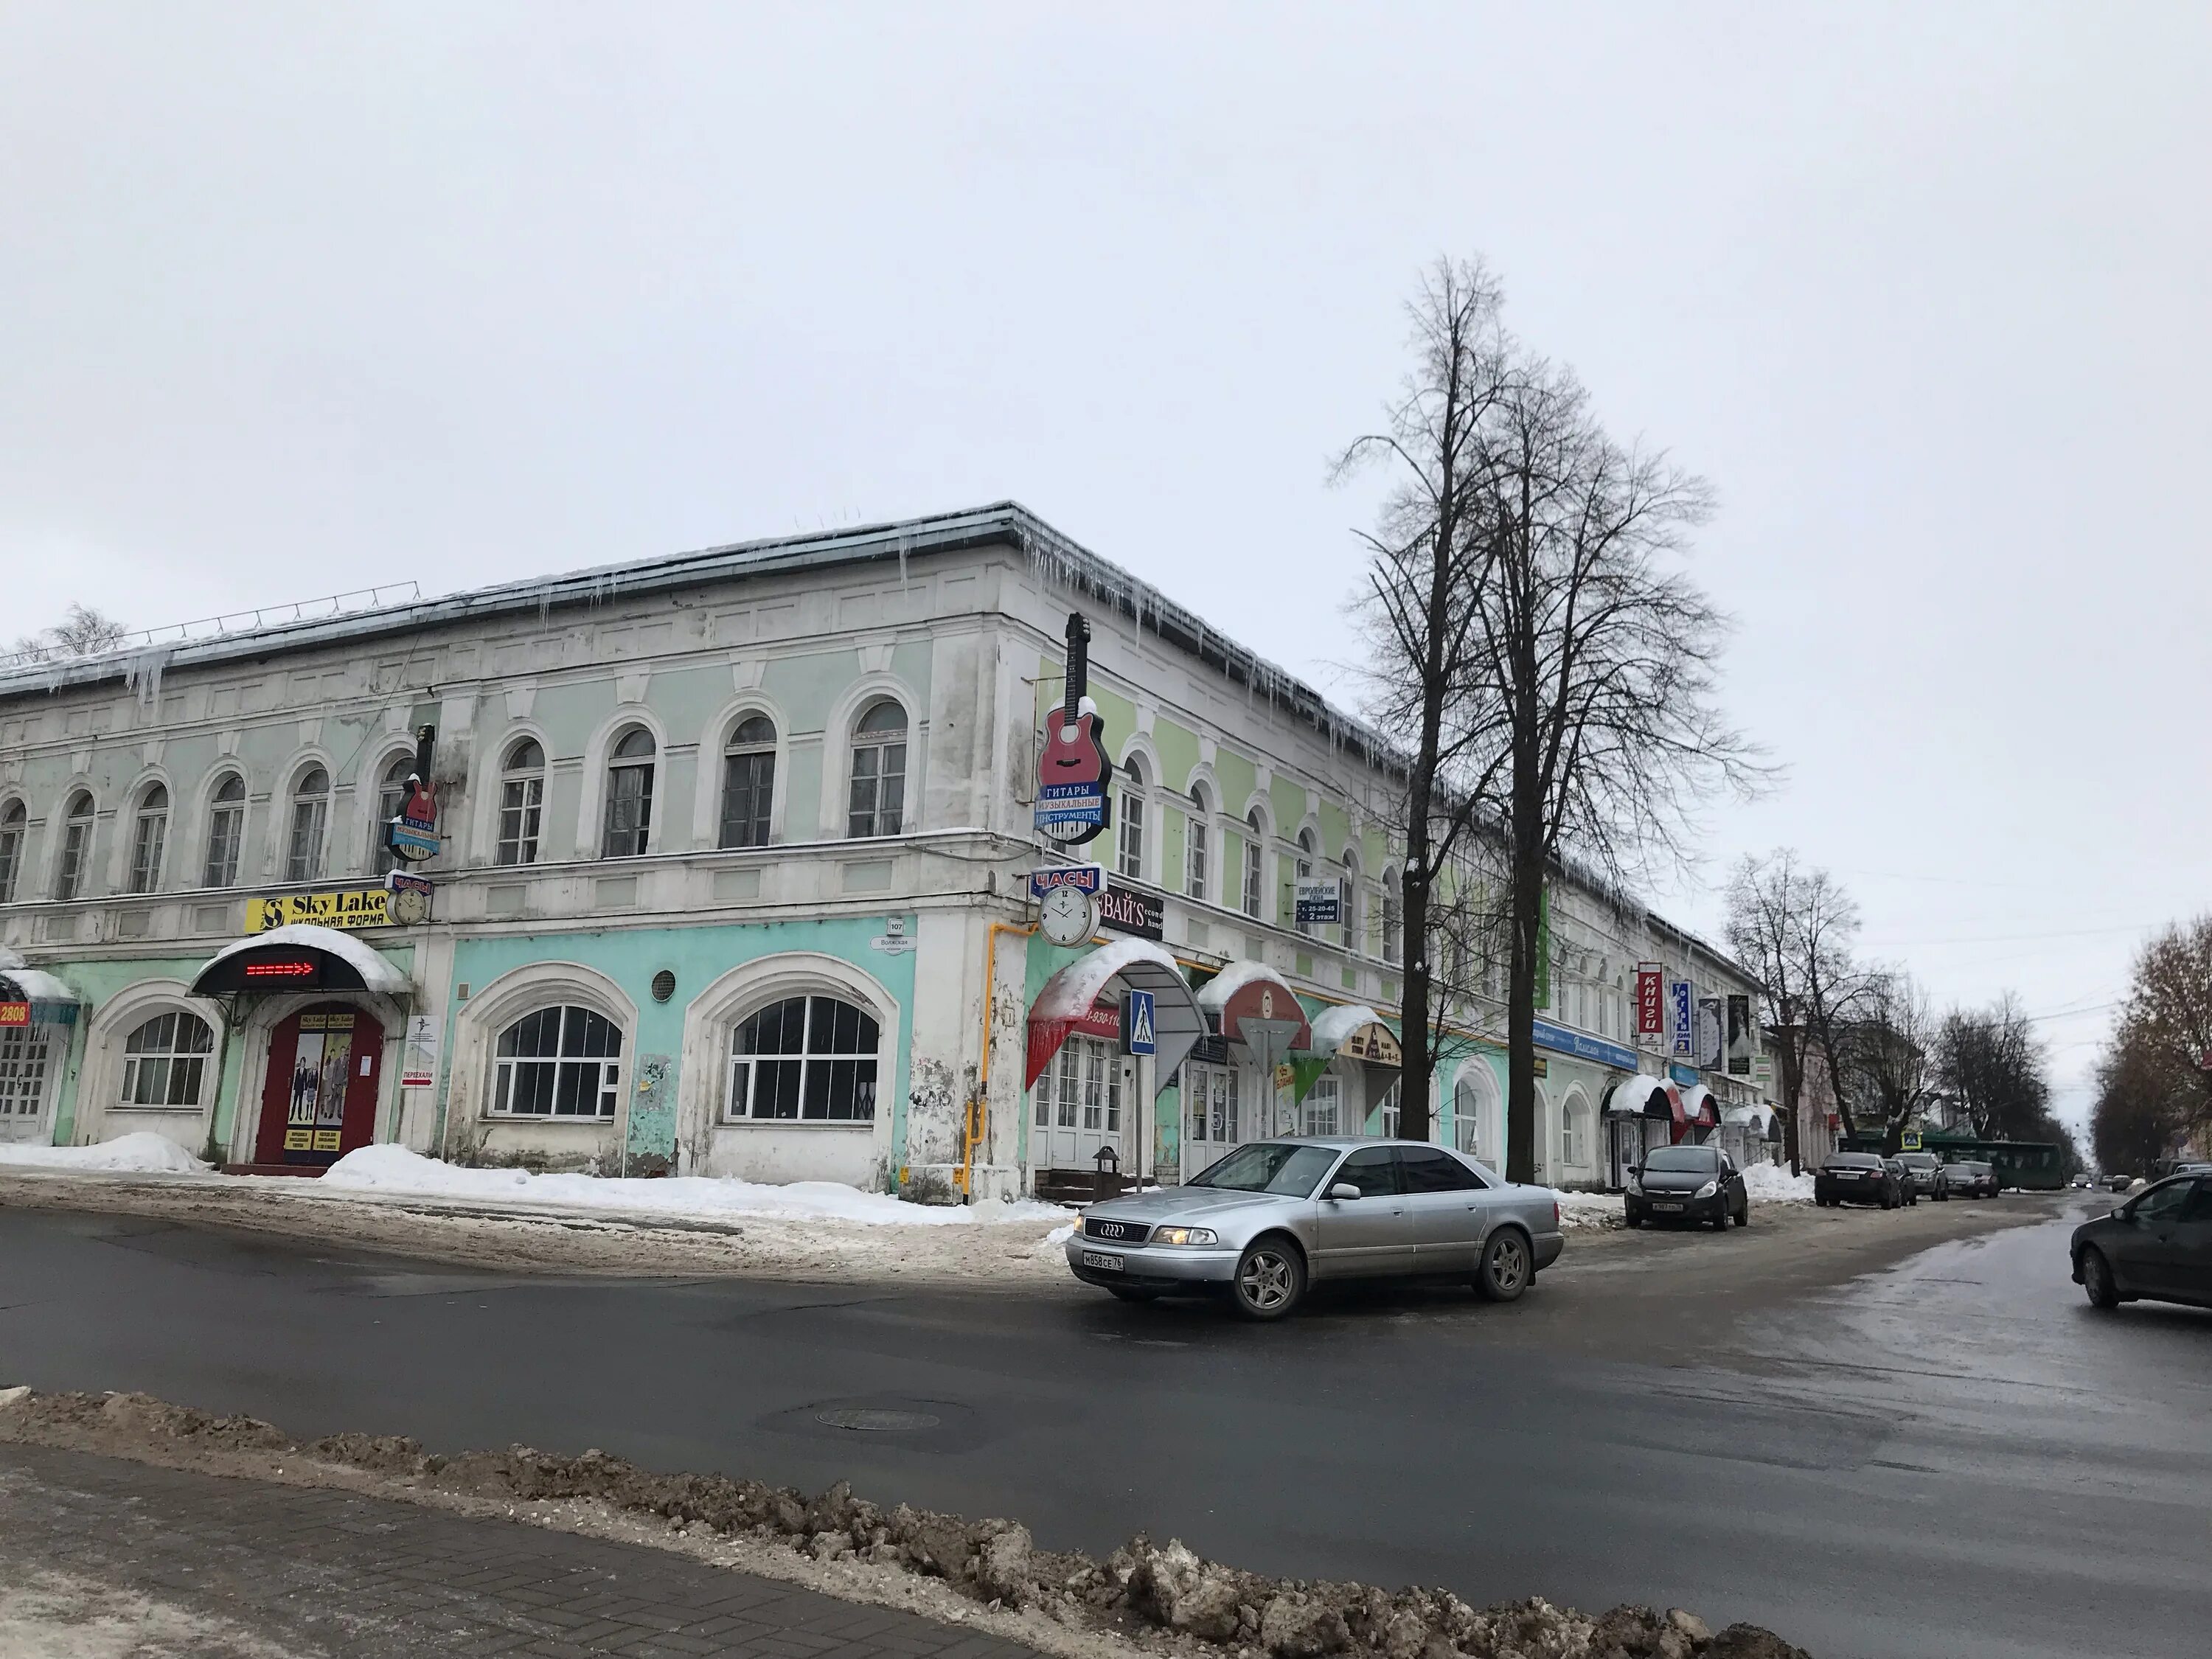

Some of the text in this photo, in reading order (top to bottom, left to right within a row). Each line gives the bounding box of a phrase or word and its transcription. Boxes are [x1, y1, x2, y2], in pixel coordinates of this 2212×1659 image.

[1046, 785, 1090, 798] ГИТАРЫ
[1037, 798, 1100, 810] МУЗЫКАЛЬНЫЕ
[1035, 810, 1102, 825] ИНСТРУМЕНТЫ
[406, 818, 434, 831] ГИТАРЫ
[394, 877, 431, 895] ЧАСЫ
[1035, 871, 1094, 889] ЧАСЫ
[1298, 886, 1335, 895] ЕВРОПЕЙСКИЕ
[292, 892, 386, 916] Sky Lake
[347, 914, 384, 926] ФОРМА
[1148, 919, 1163, 929] hand
[1, 1006, 26, 1022] 2808
[1677, 1041, 1686, 1050] 2
[1085, 1254, 1121, 1268] М858СЕ 76
